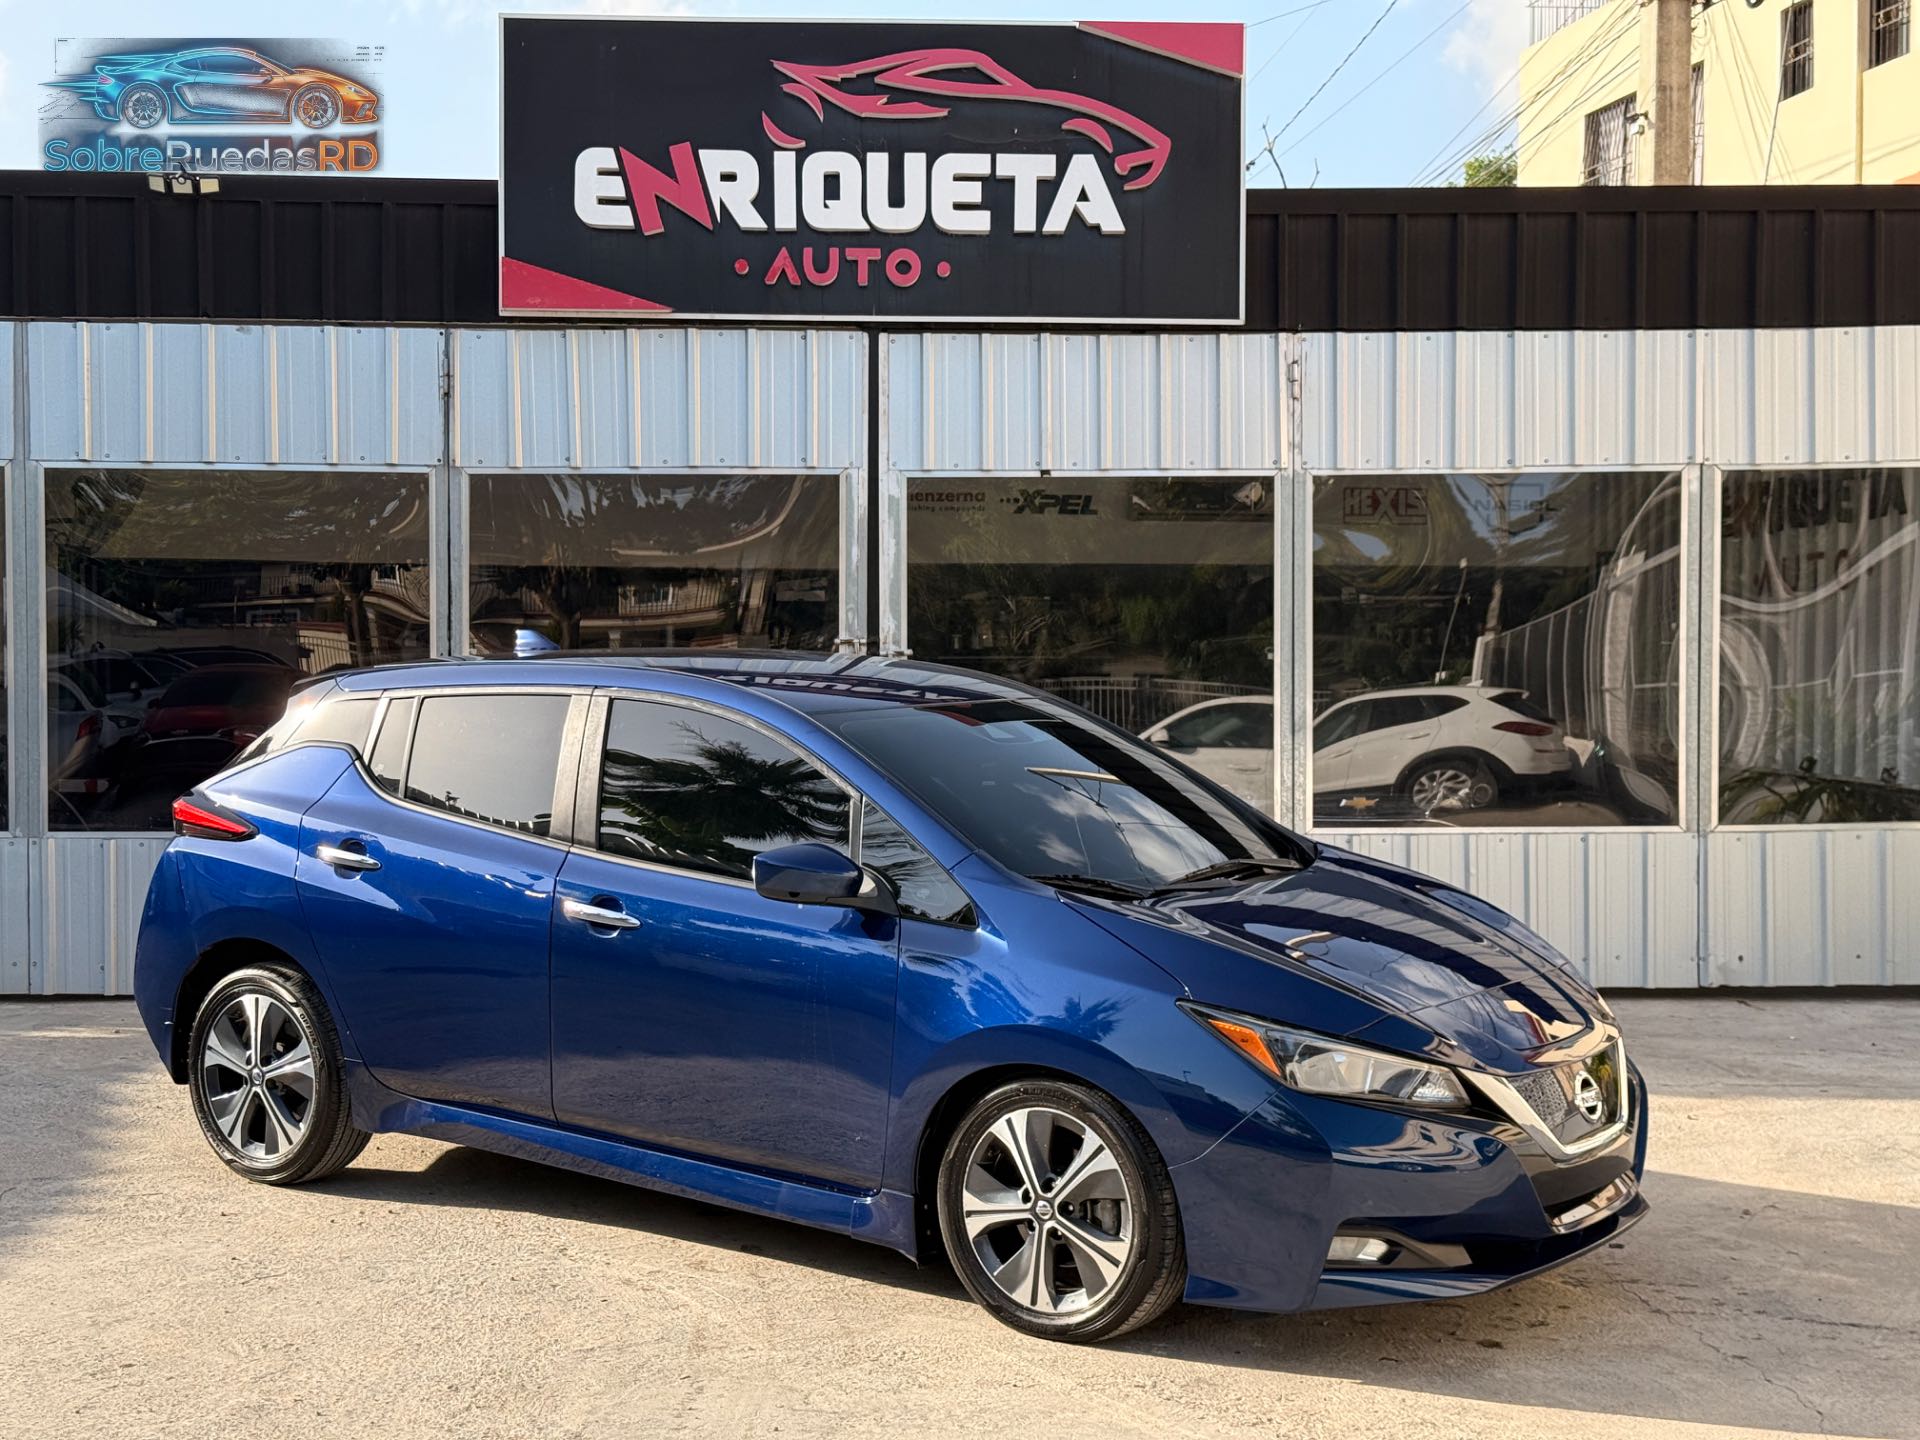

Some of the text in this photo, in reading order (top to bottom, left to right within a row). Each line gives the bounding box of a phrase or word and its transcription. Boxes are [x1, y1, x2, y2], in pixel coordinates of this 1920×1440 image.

[573, 141, 1126, 236] ENRIQUETA
[764, 247, 921, 288] AUTO
[909, 491, 986, 503] enzerna
[1012, 488, 1098, 515] XPEL
[1343, 487, 1428, 525] HEXIS
